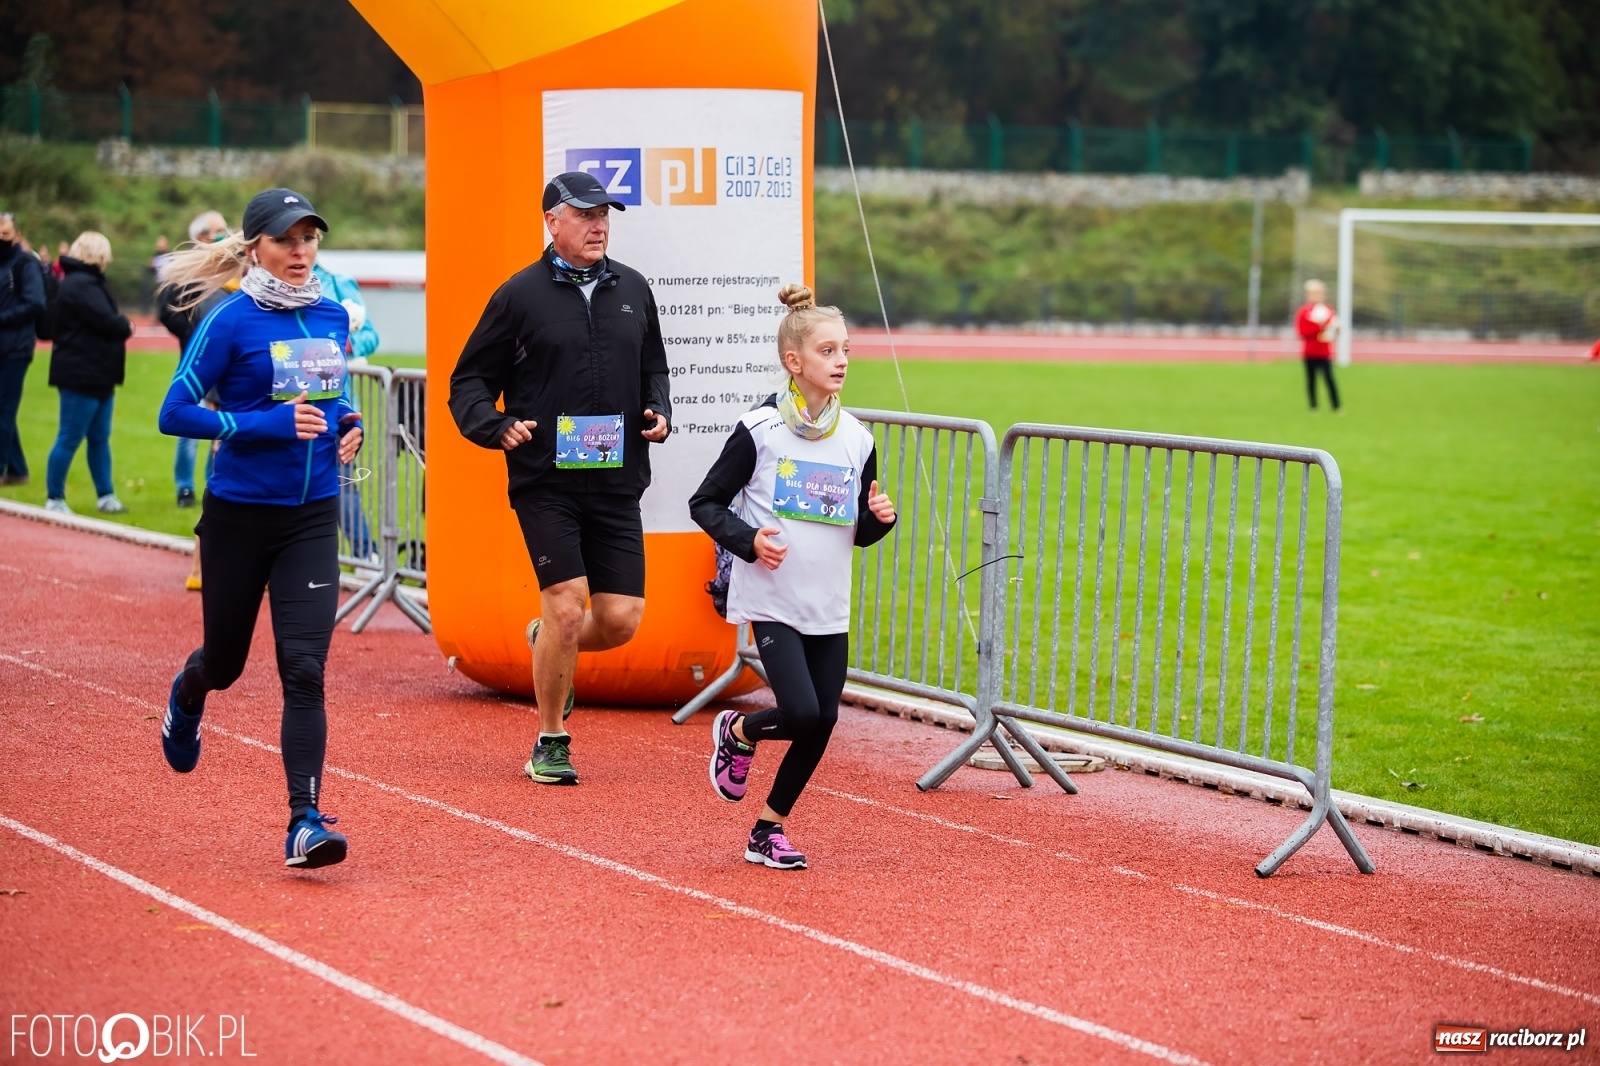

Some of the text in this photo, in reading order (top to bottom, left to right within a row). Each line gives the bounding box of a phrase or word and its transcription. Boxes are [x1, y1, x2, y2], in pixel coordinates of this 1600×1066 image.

[661, 148, 703, 206] pl
[658, 276, 709, 286] numerze
[712, 274, 780, 287] rejestracyjnym
[657, 304, 703, 316] 9.01281
[707, 306, 725, 317] pn:
[757, 304, 772, 314] bez
[715, 336, 725, 344] w
[727, 333, 748, 344] 85%
[750, 335, 760, 344] ze
[690, 364, 743, 375] Funduszu
[320, 378, 341, 391] 115
[673, 396, 698, 404] oraz
[701, 393, 716, 404] do
[719, 393, 740, 404] 10%
[743, 394, 754, 403] ze
[566, 434, 581, 442] BIEG
[597, 451, 618, 463] 272
[786, 479, 803, 489] BIEG
[806, 481, 820, 491] DLA
[820, 504, 847, 518] 096
